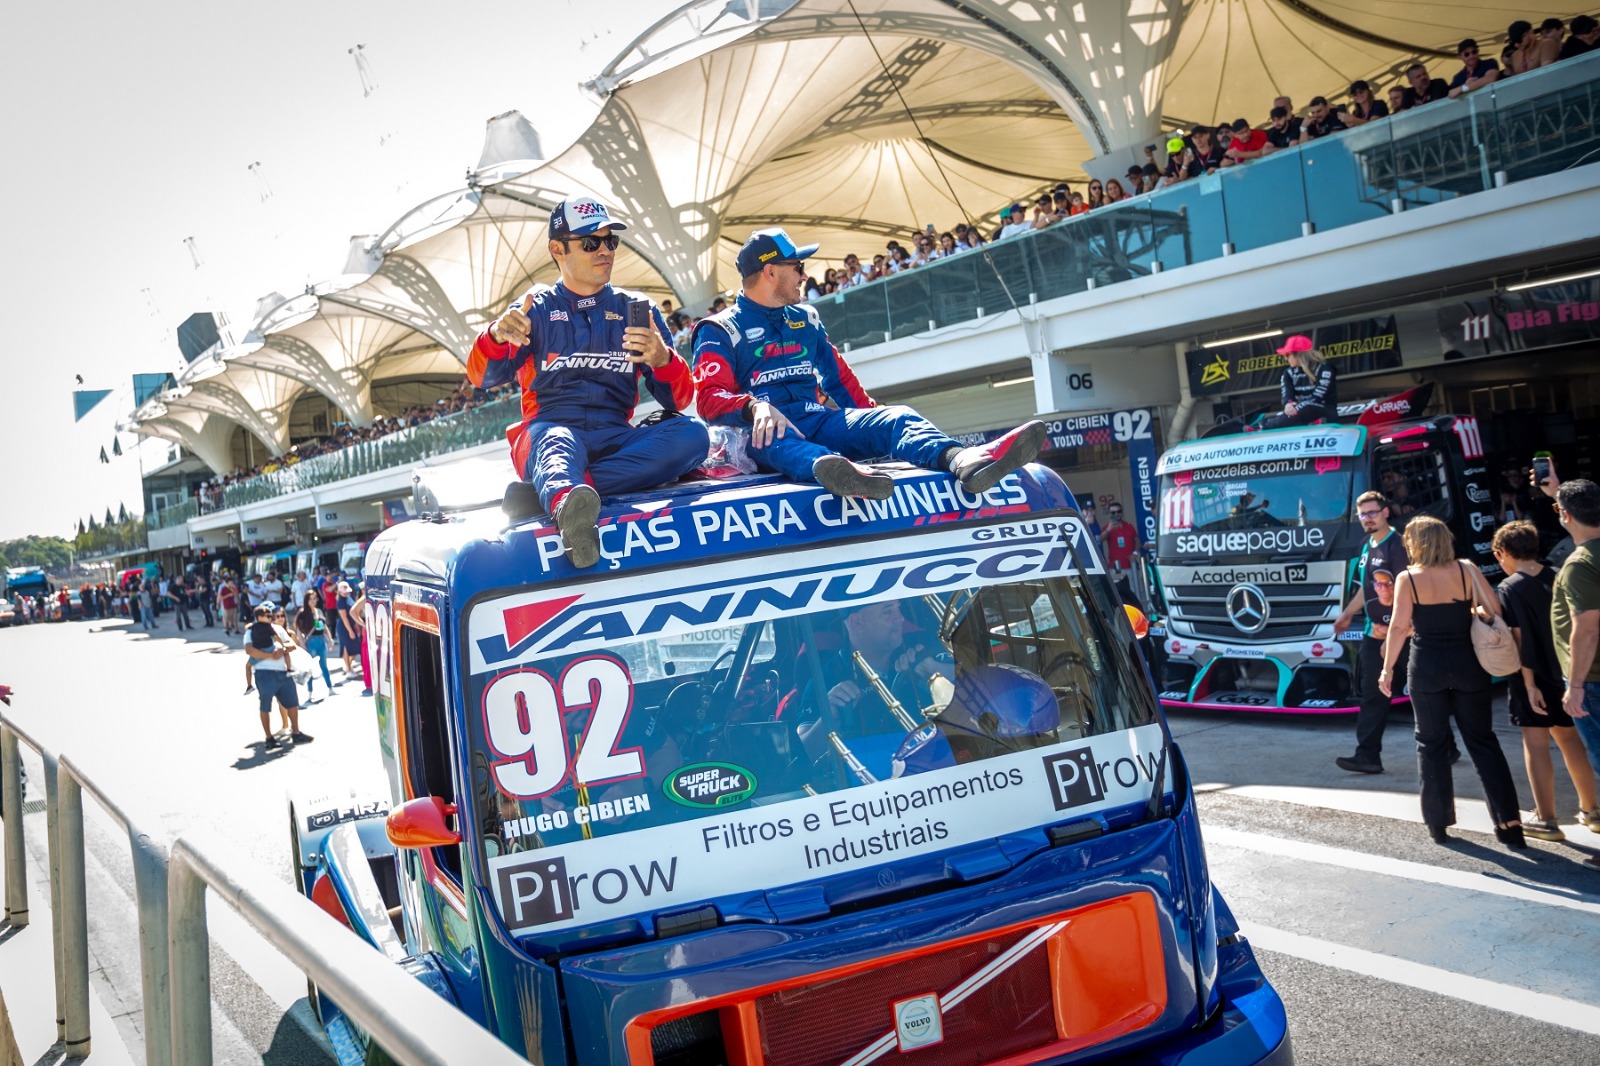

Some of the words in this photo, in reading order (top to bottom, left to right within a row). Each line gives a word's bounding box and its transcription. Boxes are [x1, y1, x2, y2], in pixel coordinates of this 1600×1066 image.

[1460, 314, 1490, 341] 111
[1506, 309, 1552, 331] Bia
[1556, 301, 1600, 323] Fig
[750, 364, 812, 386] VANNUCCI
[1237, 354, 1289, 373] ROBER
[1068, 373, 1093, 391] 06
[1046, 418, 1063, 434] GO
[1066, 414, 1109, 431] CIBIEN
[1113, 409, 1152, 442] 92
[1053, 434, 1084, 449] VOLVO
[1305, 437, 1337, 449] LNG
[1452, 416, 1484, 459] 111
[1184, 453, 1202, 463] LNG
[1203, 444, 1264, 461] AUTOMOTIVE
[1266, 441, 1301, 453] PARTS
[1192, 458, 1309, 480] avozdelas.com.br
[1138, 457, 1152, 512] CIBIEN
[1162, 487, 1192, 529] 111
[535, 514, 681, 572] PÇAS
[691, 499, 807, 545] PARA
[971, 522, 1078, 541] GRUPO
[1191, 568, 1282, 584] Academia
[1288, 569, 1306, 581] px
[475, 533, 1094, 665] VANNUCCI
[1340, 632, 1363, 640] MAHL
[481, 654, 647, 800] 92
[679, 768, 720, 787] SUPER
[687, 774, 741, 799] TRUCK
[1052, 748, 1168, 803] Pirow
[505, 810, 569, 838] HUGO
[573, 793, 651, 825] CIBIEN
[702, 817, 794, 853] Filtros
[803, 813, 821, 832] e
[829, 768, 1024, 828] Equipamentos
[804, 817, 949, 869] Industriais
[509, 857, 678, 922] Pirow
[904, 1016, 931, 1030] VOLVO
